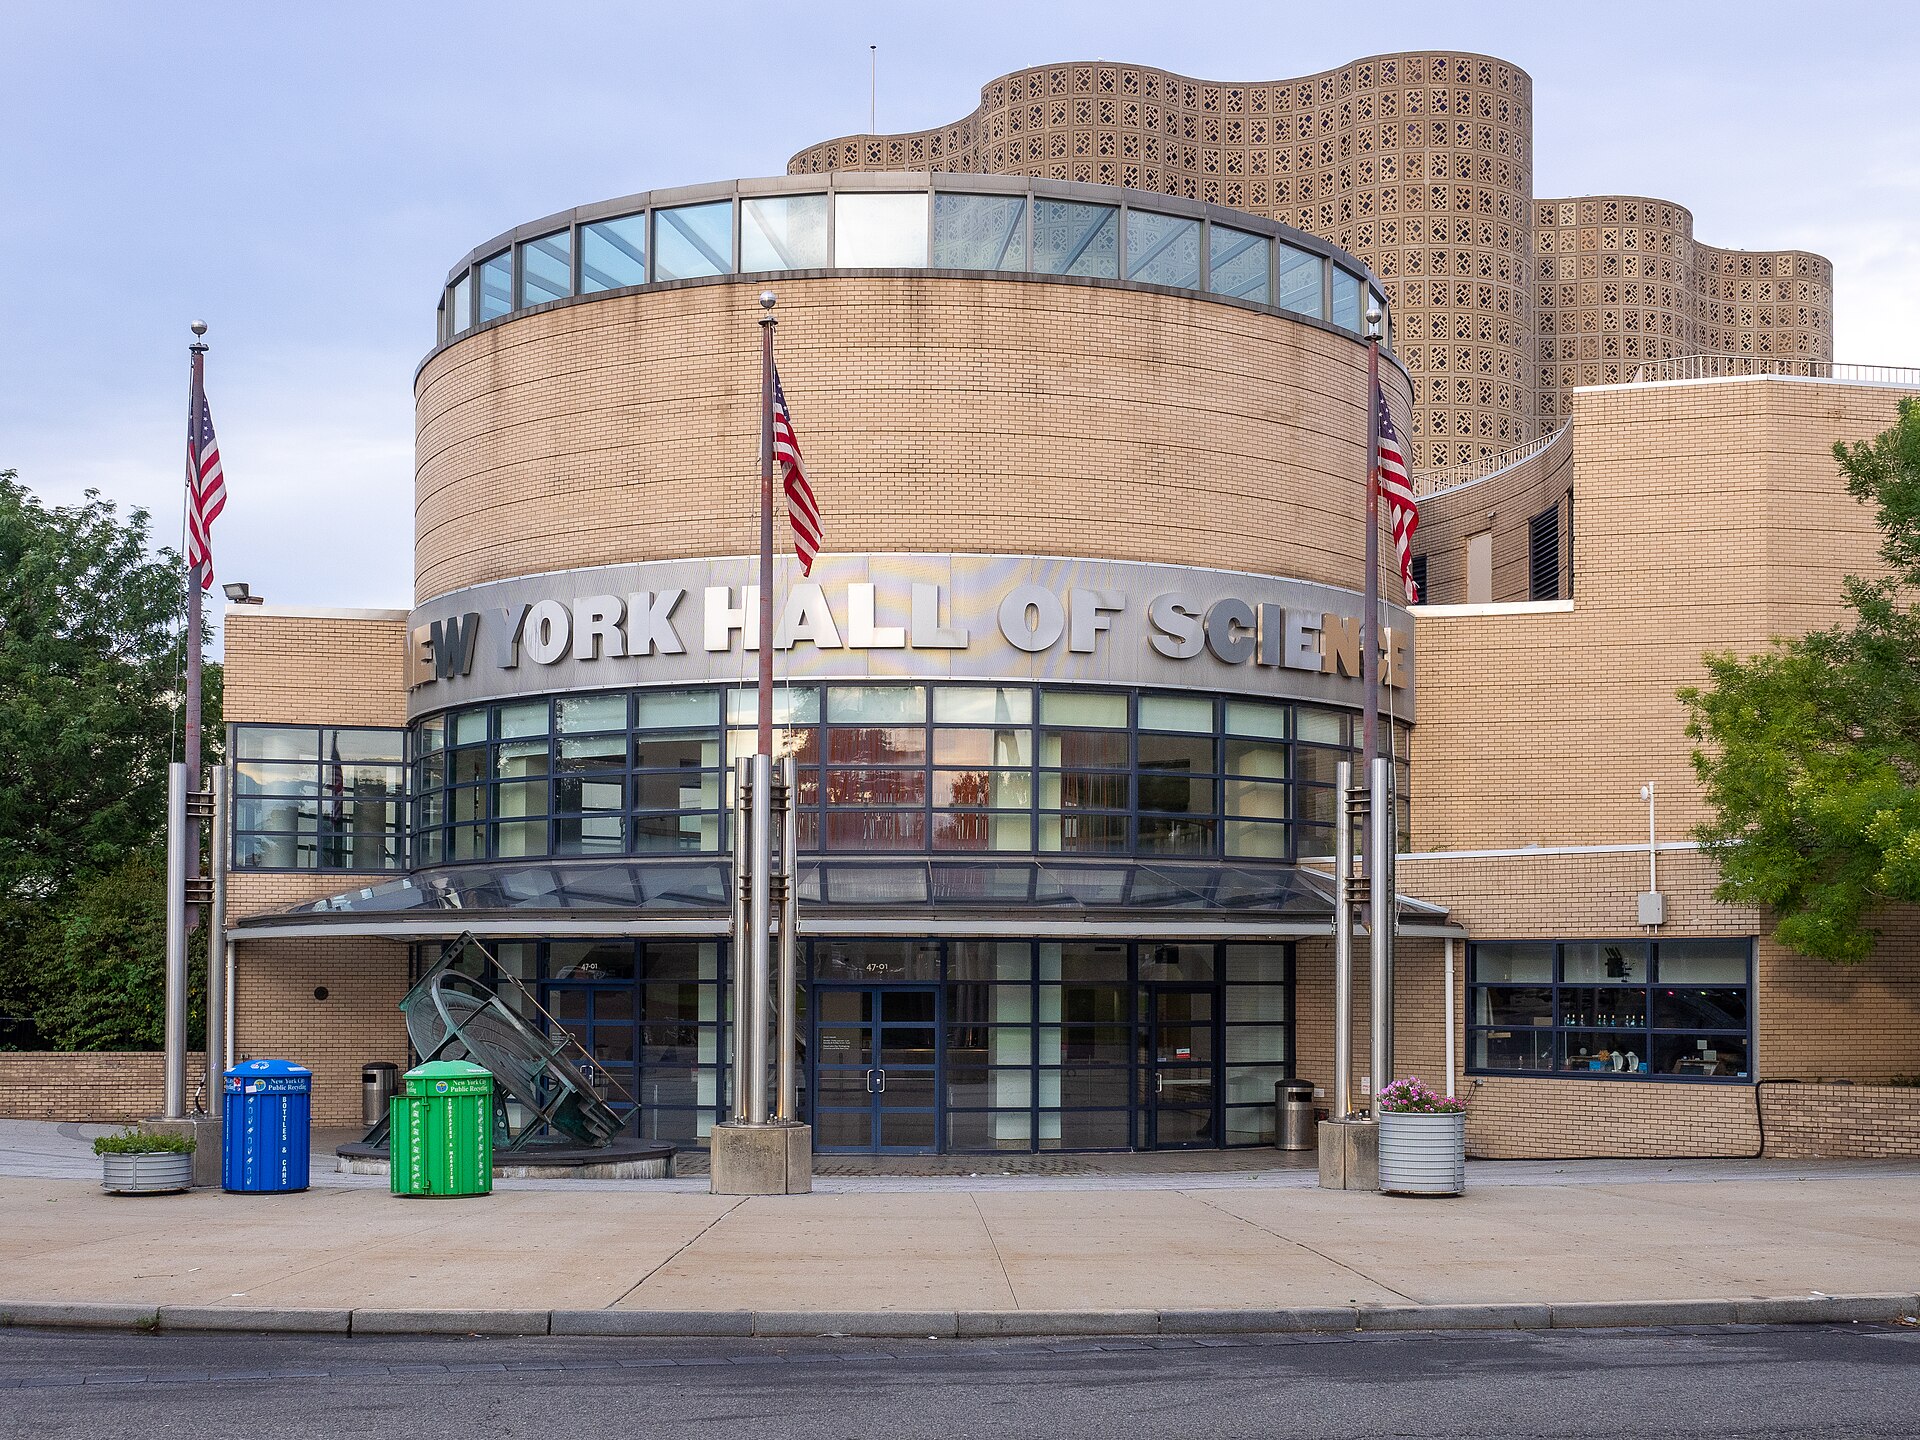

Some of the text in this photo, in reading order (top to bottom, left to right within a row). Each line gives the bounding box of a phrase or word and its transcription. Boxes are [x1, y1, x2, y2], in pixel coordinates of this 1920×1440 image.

[486, 588, 687, 669] YORK
[704, 583, 969, 651] HALL
[997, 585, 1126, 653] OF
[581, 963, 598, 971] 47-01
[866, 963, 888, 971] 47-01
